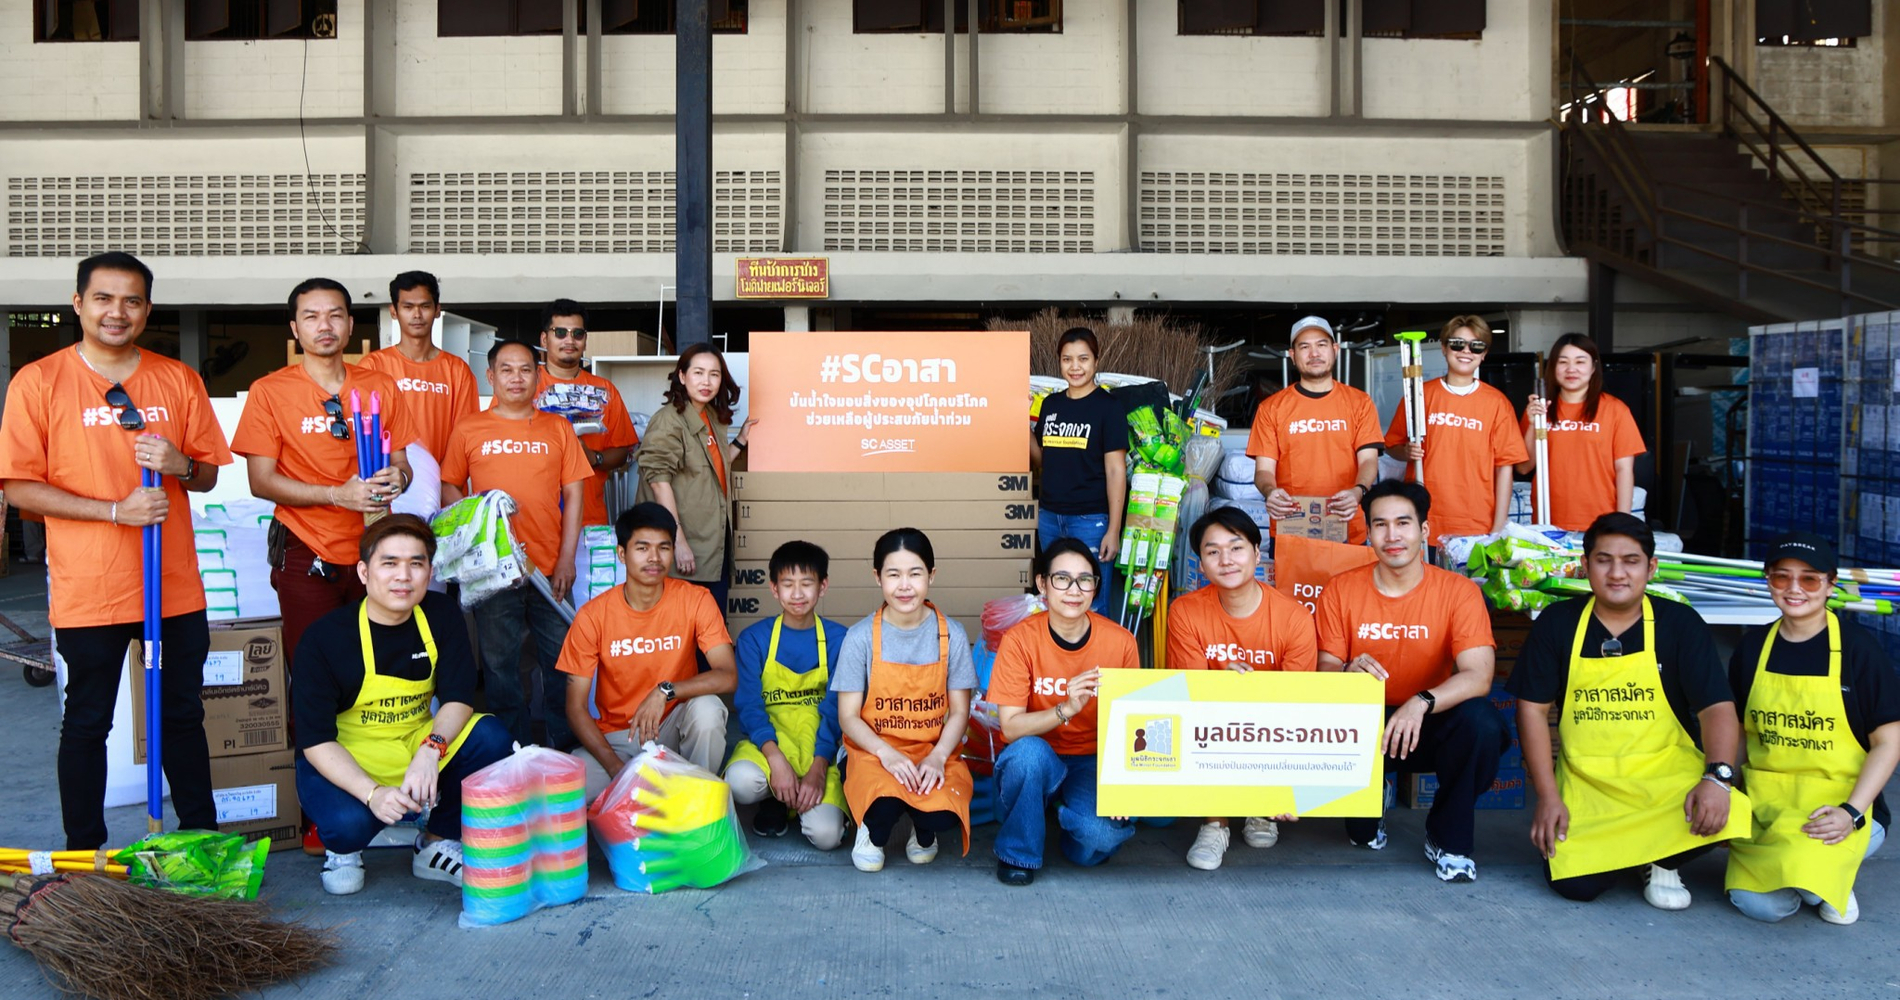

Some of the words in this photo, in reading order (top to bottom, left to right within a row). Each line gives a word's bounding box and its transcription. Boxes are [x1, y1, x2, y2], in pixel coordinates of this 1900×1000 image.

[820, 353, 957, 383] #SCอาสา
[1289, 418, 1347, 434] #SCอาสา
[1428, 412, 1483, 431] #SCอาสา
[481, 439, 549, 456] #SCอาสา
[861, 438, 878, 449] SC
[879, 438, 915, 449] ASSET
[998, 475, 1028, 491] 3M
[1004, 504, 1035, 520] 3M
[1000, 534, 1031, 549] 3M
[1358, 622, 1429, 640] #SCอาสา
[610, 635, 682, 657] #SCอาสา
[1205, 643, 1275, 664] #SCอาสา
[1573, 682, 1655, 702] อาสาสมัคร
[875, 692, 945, 712] อาสาสมัคร
[1573, 706, 1656, 725] มูลนิธิกระจกเงา
[1194, 722, 1359, 748] มูลนิธิกระจกเงา
